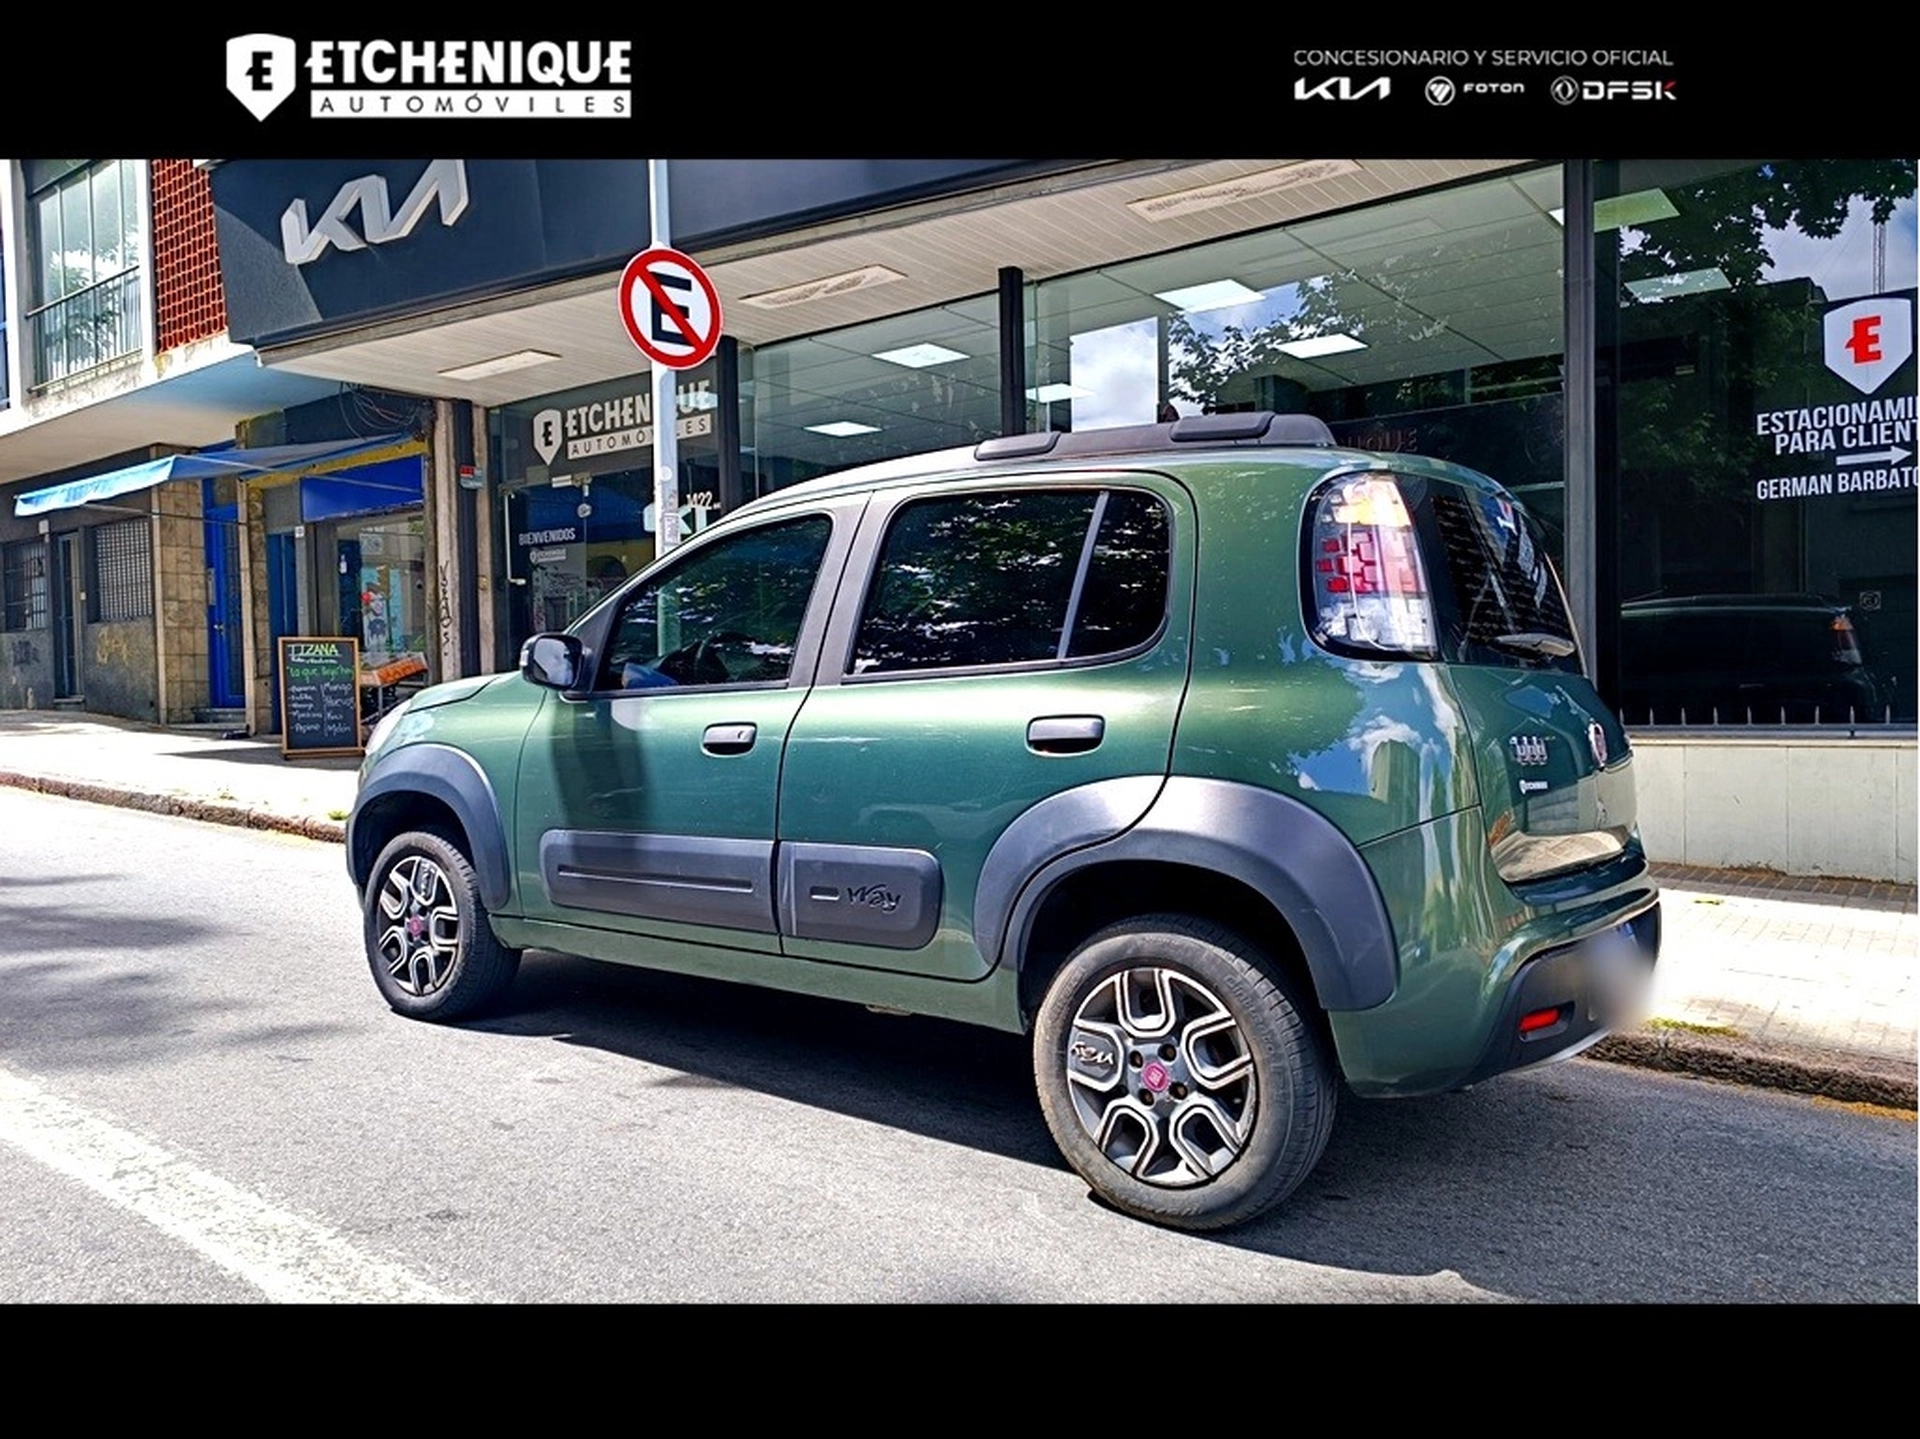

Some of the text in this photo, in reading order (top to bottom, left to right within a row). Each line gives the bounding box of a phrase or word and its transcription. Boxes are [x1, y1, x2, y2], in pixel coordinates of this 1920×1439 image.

[1757, 396, 1918, 435] ESTACIONAMI
[1775, 428, 1836, 455] PARA
[1757, 474, 1832, 499] GERMAN
[518, 527, 576, 546] BIENVENIDOS
